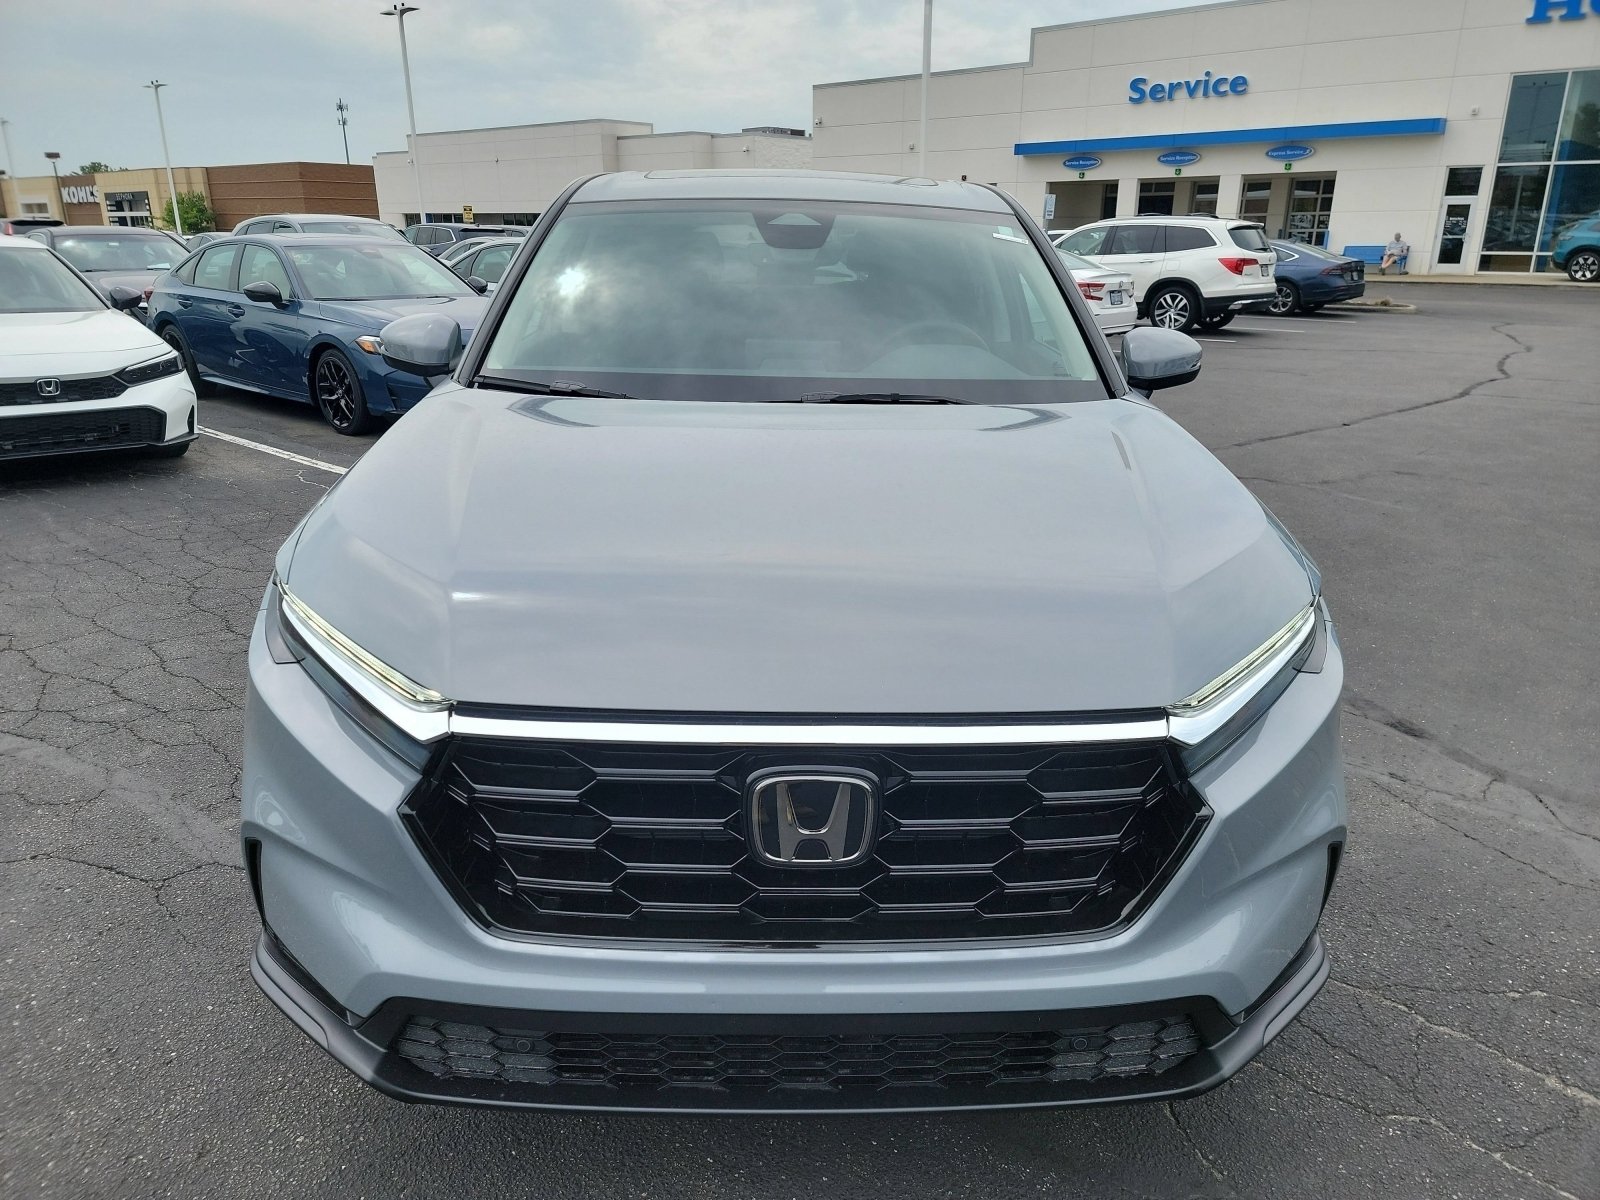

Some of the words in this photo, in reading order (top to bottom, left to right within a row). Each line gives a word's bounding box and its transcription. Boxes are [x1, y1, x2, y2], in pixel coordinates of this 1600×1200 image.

[1525, 0, 1600, 25] H
[1128, 70, 1249, 105] Service
[60, 185, 100, 204] KOHL'S
